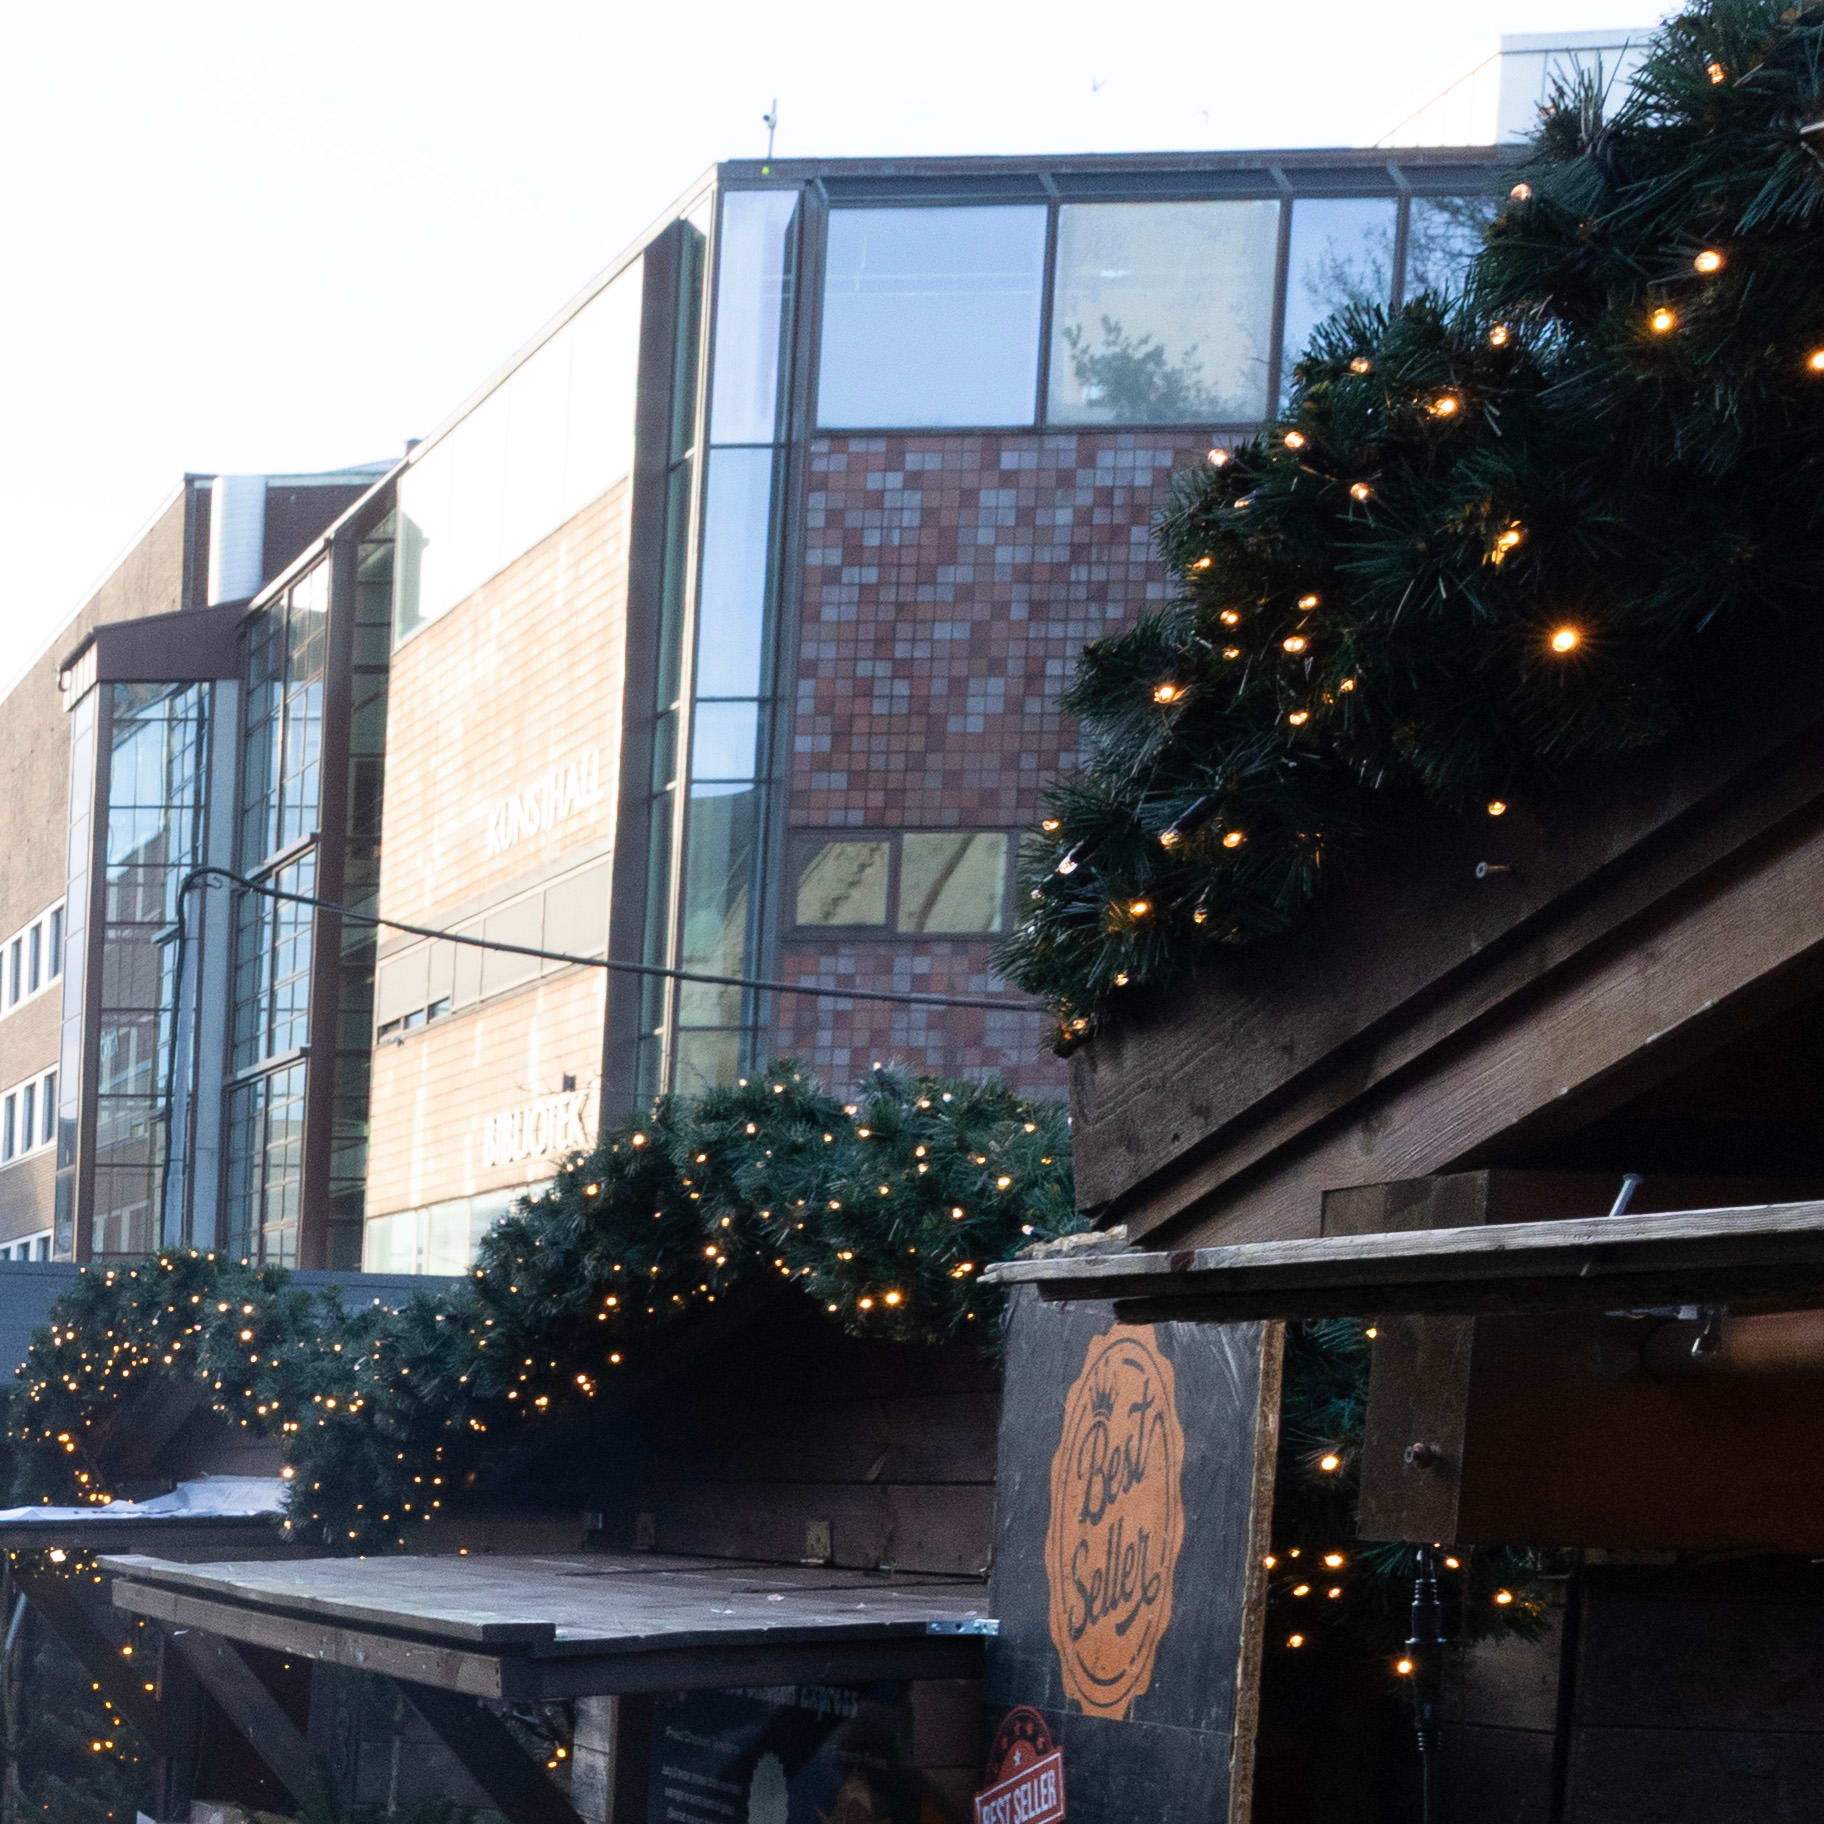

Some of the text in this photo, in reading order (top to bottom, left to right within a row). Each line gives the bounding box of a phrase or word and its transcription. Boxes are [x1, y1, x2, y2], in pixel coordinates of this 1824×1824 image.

[488, 749, 603, 855] KUNSTHALL
[483, 1091, 589, 1168] BIBLIOTEK
[1077, 1376, 1158, 1527] Best
[1070, 1520, 1159, 1641] Seller
